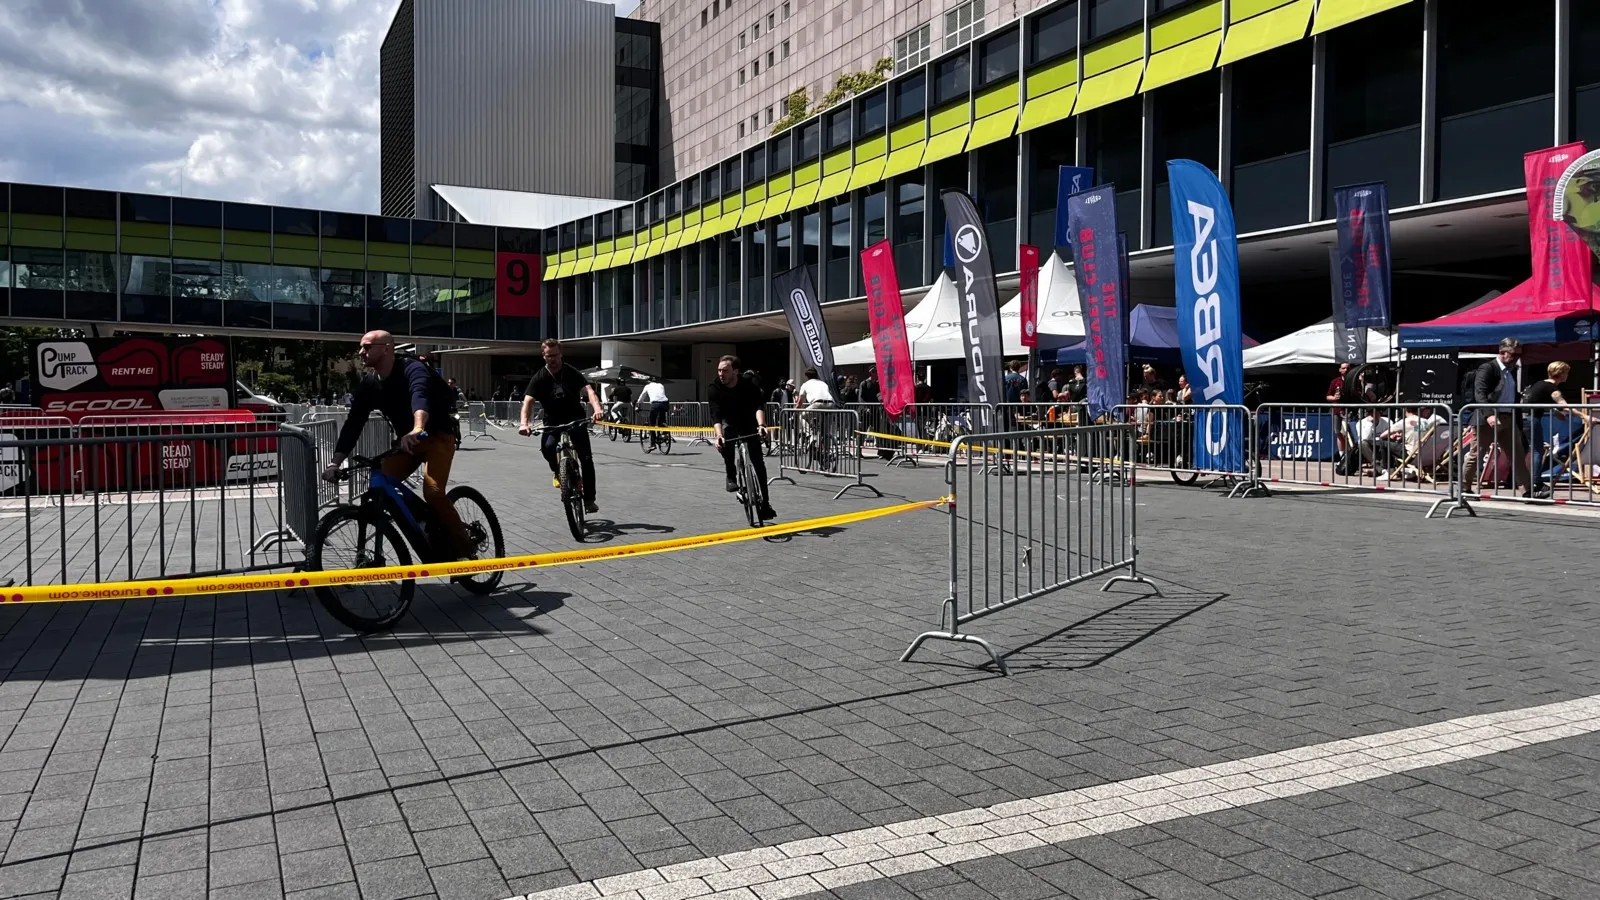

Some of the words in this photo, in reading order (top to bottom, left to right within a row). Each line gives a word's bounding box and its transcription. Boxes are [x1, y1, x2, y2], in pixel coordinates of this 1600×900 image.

[506, 259, 530, 296] 9
[41, 348, 76, 370] PUMP
[201, 352, 224, 362] READY
[54, 363, 88, 379] TRACK
[111, 367, 136, 376] RENT
[201, 362, 225, 370] STEADY
[45, 398, 153, 412] SCOOL
[1284, 417, 1307, 430] THE
[1270, 429, 1323, 445] GRAVEL
[1277, 444, 1313, 459] CLUB
[228, 459, 278, 472] SCOOL
[330, 573, 403, 582] Eurobike.com
[197, 581, 280, 591] Eurobike.com
[49, 589, 140, 599] Eurobike.com
